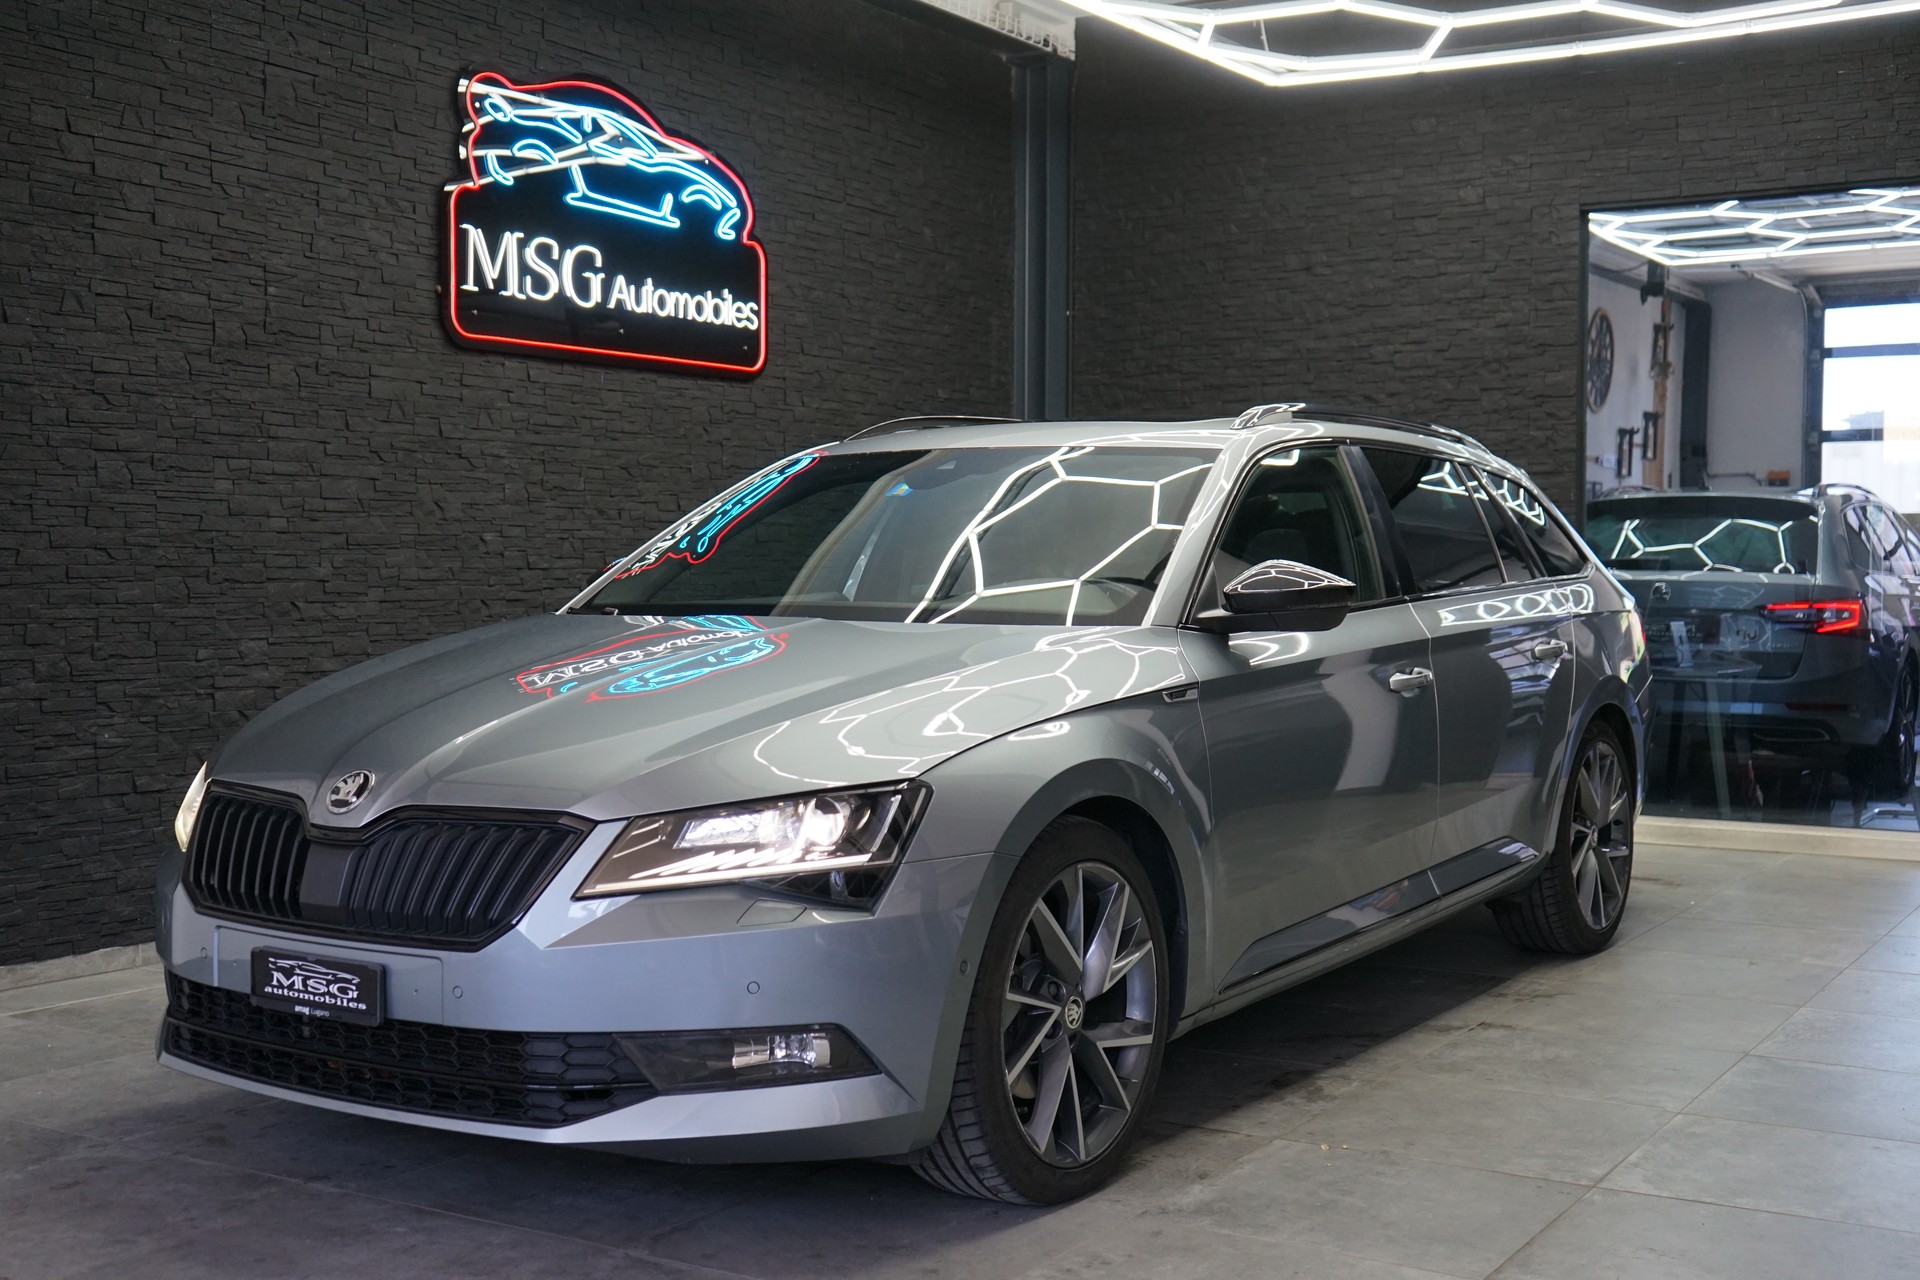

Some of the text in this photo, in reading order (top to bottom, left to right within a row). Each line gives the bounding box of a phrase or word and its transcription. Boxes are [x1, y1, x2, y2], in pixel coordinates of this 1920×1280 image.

[459, 223, 760, 331] MSG Automobiles
[264, 986, 367, 1010] automobiles
[271, 971, 359, 998] MSG
